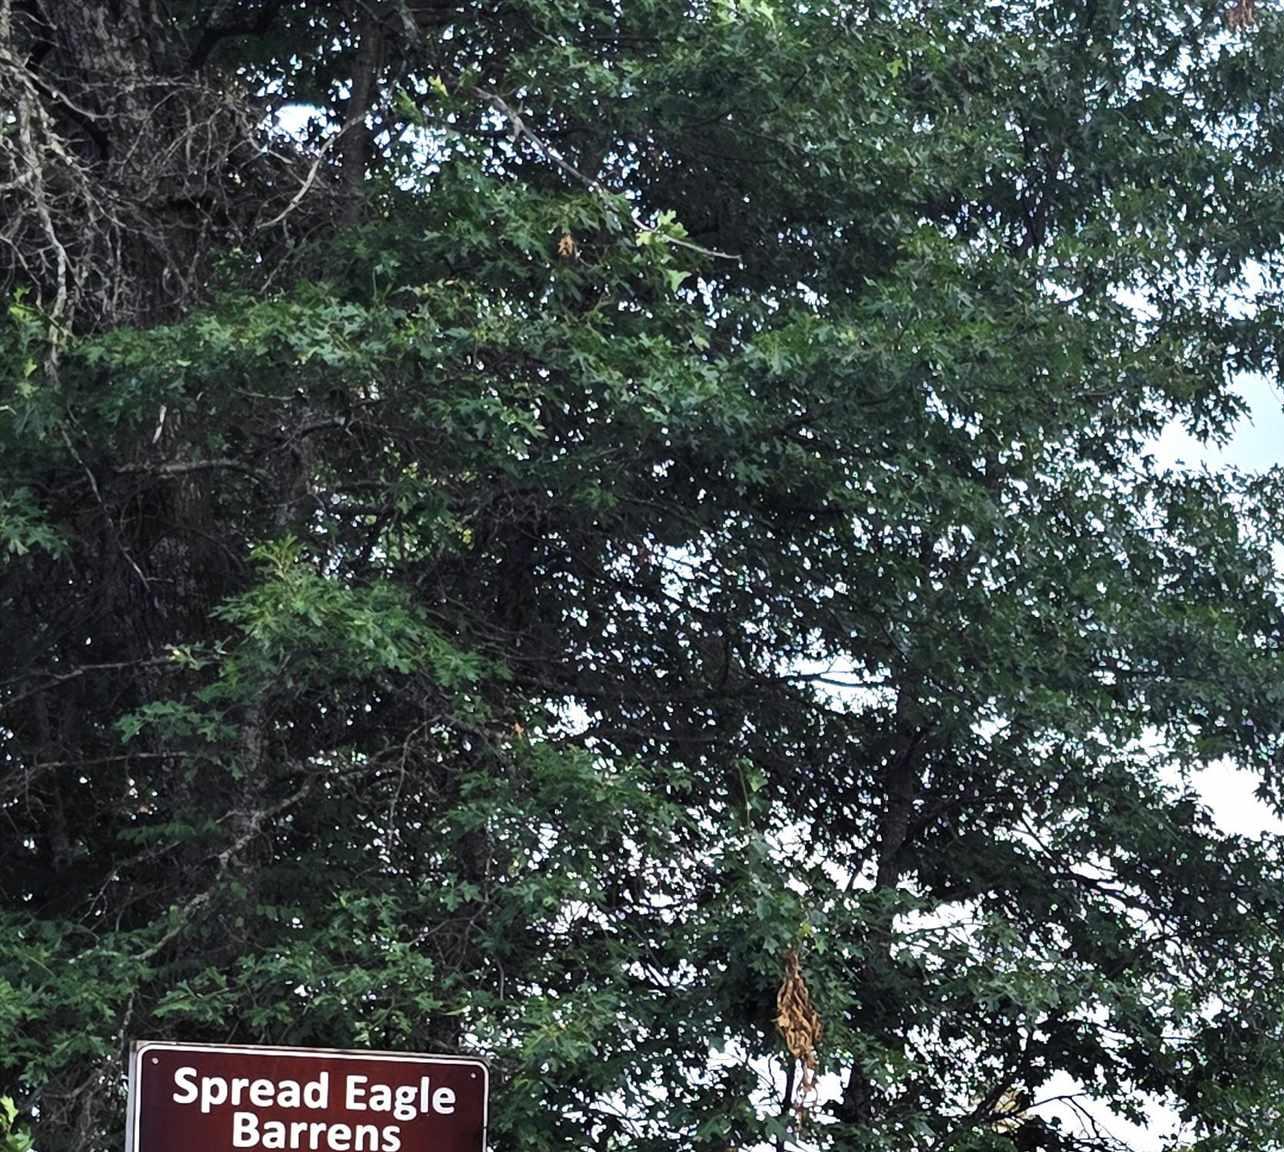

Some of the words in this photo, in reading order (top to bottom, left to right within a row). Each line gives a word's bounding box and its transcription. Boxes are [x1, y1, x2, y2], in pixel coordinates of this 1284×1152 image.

[173, 1066, 329, 1113] Spread
[346, 1075, 456, 1121] Eagle
[232, 1111, 402, 1152] Barrens
